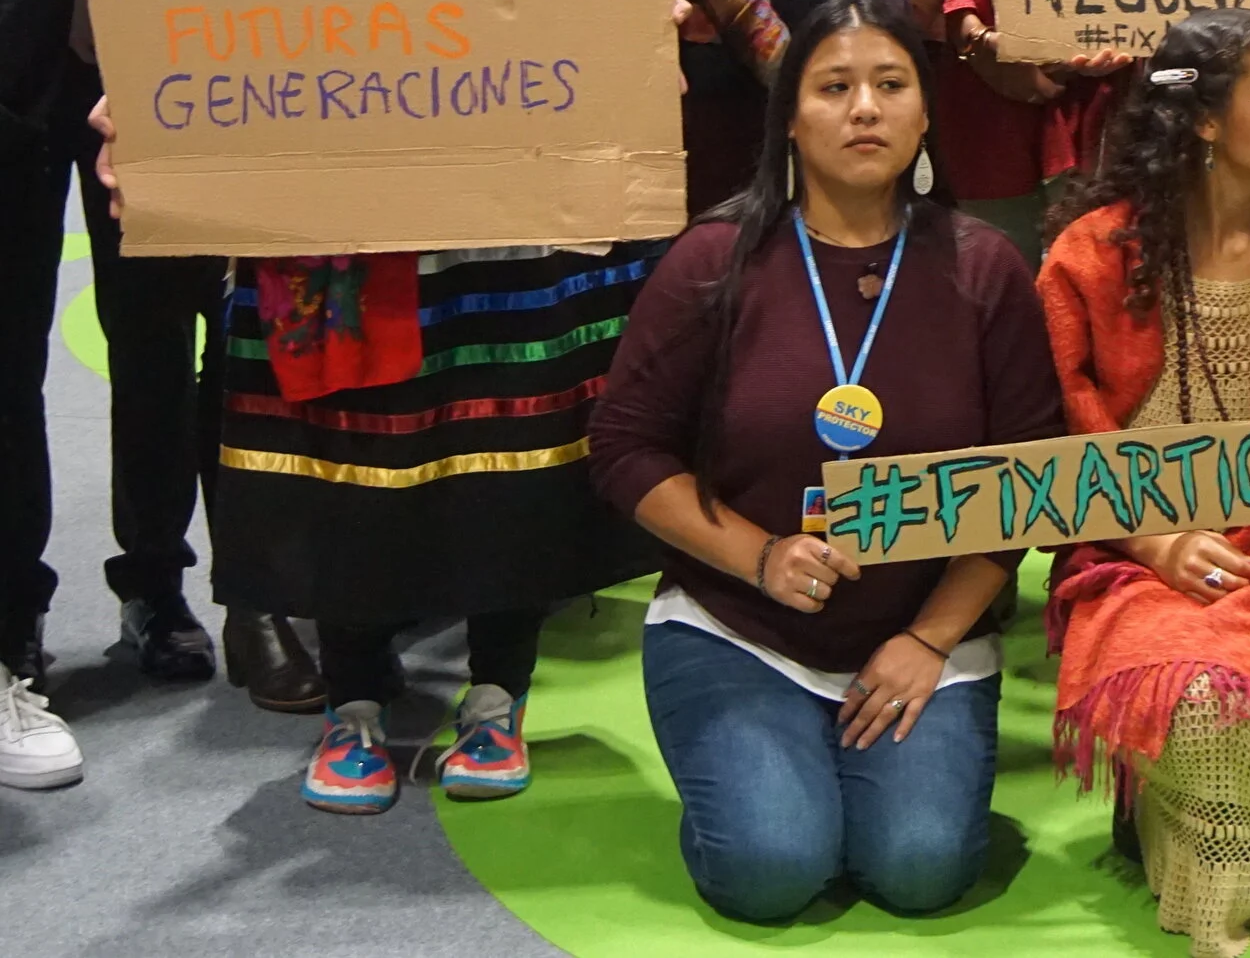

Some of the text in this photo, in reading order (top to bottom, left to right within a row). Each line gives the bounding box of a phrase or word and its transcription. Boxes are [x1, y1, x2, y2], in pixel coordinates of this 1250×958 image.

[165, 1, 471, 64] FUTURAS
[153, 59, 580, 129] GENERACIONES
[816, 411, 880, 438] PROTECTOR
[834, 400, 872, 421] SKY
